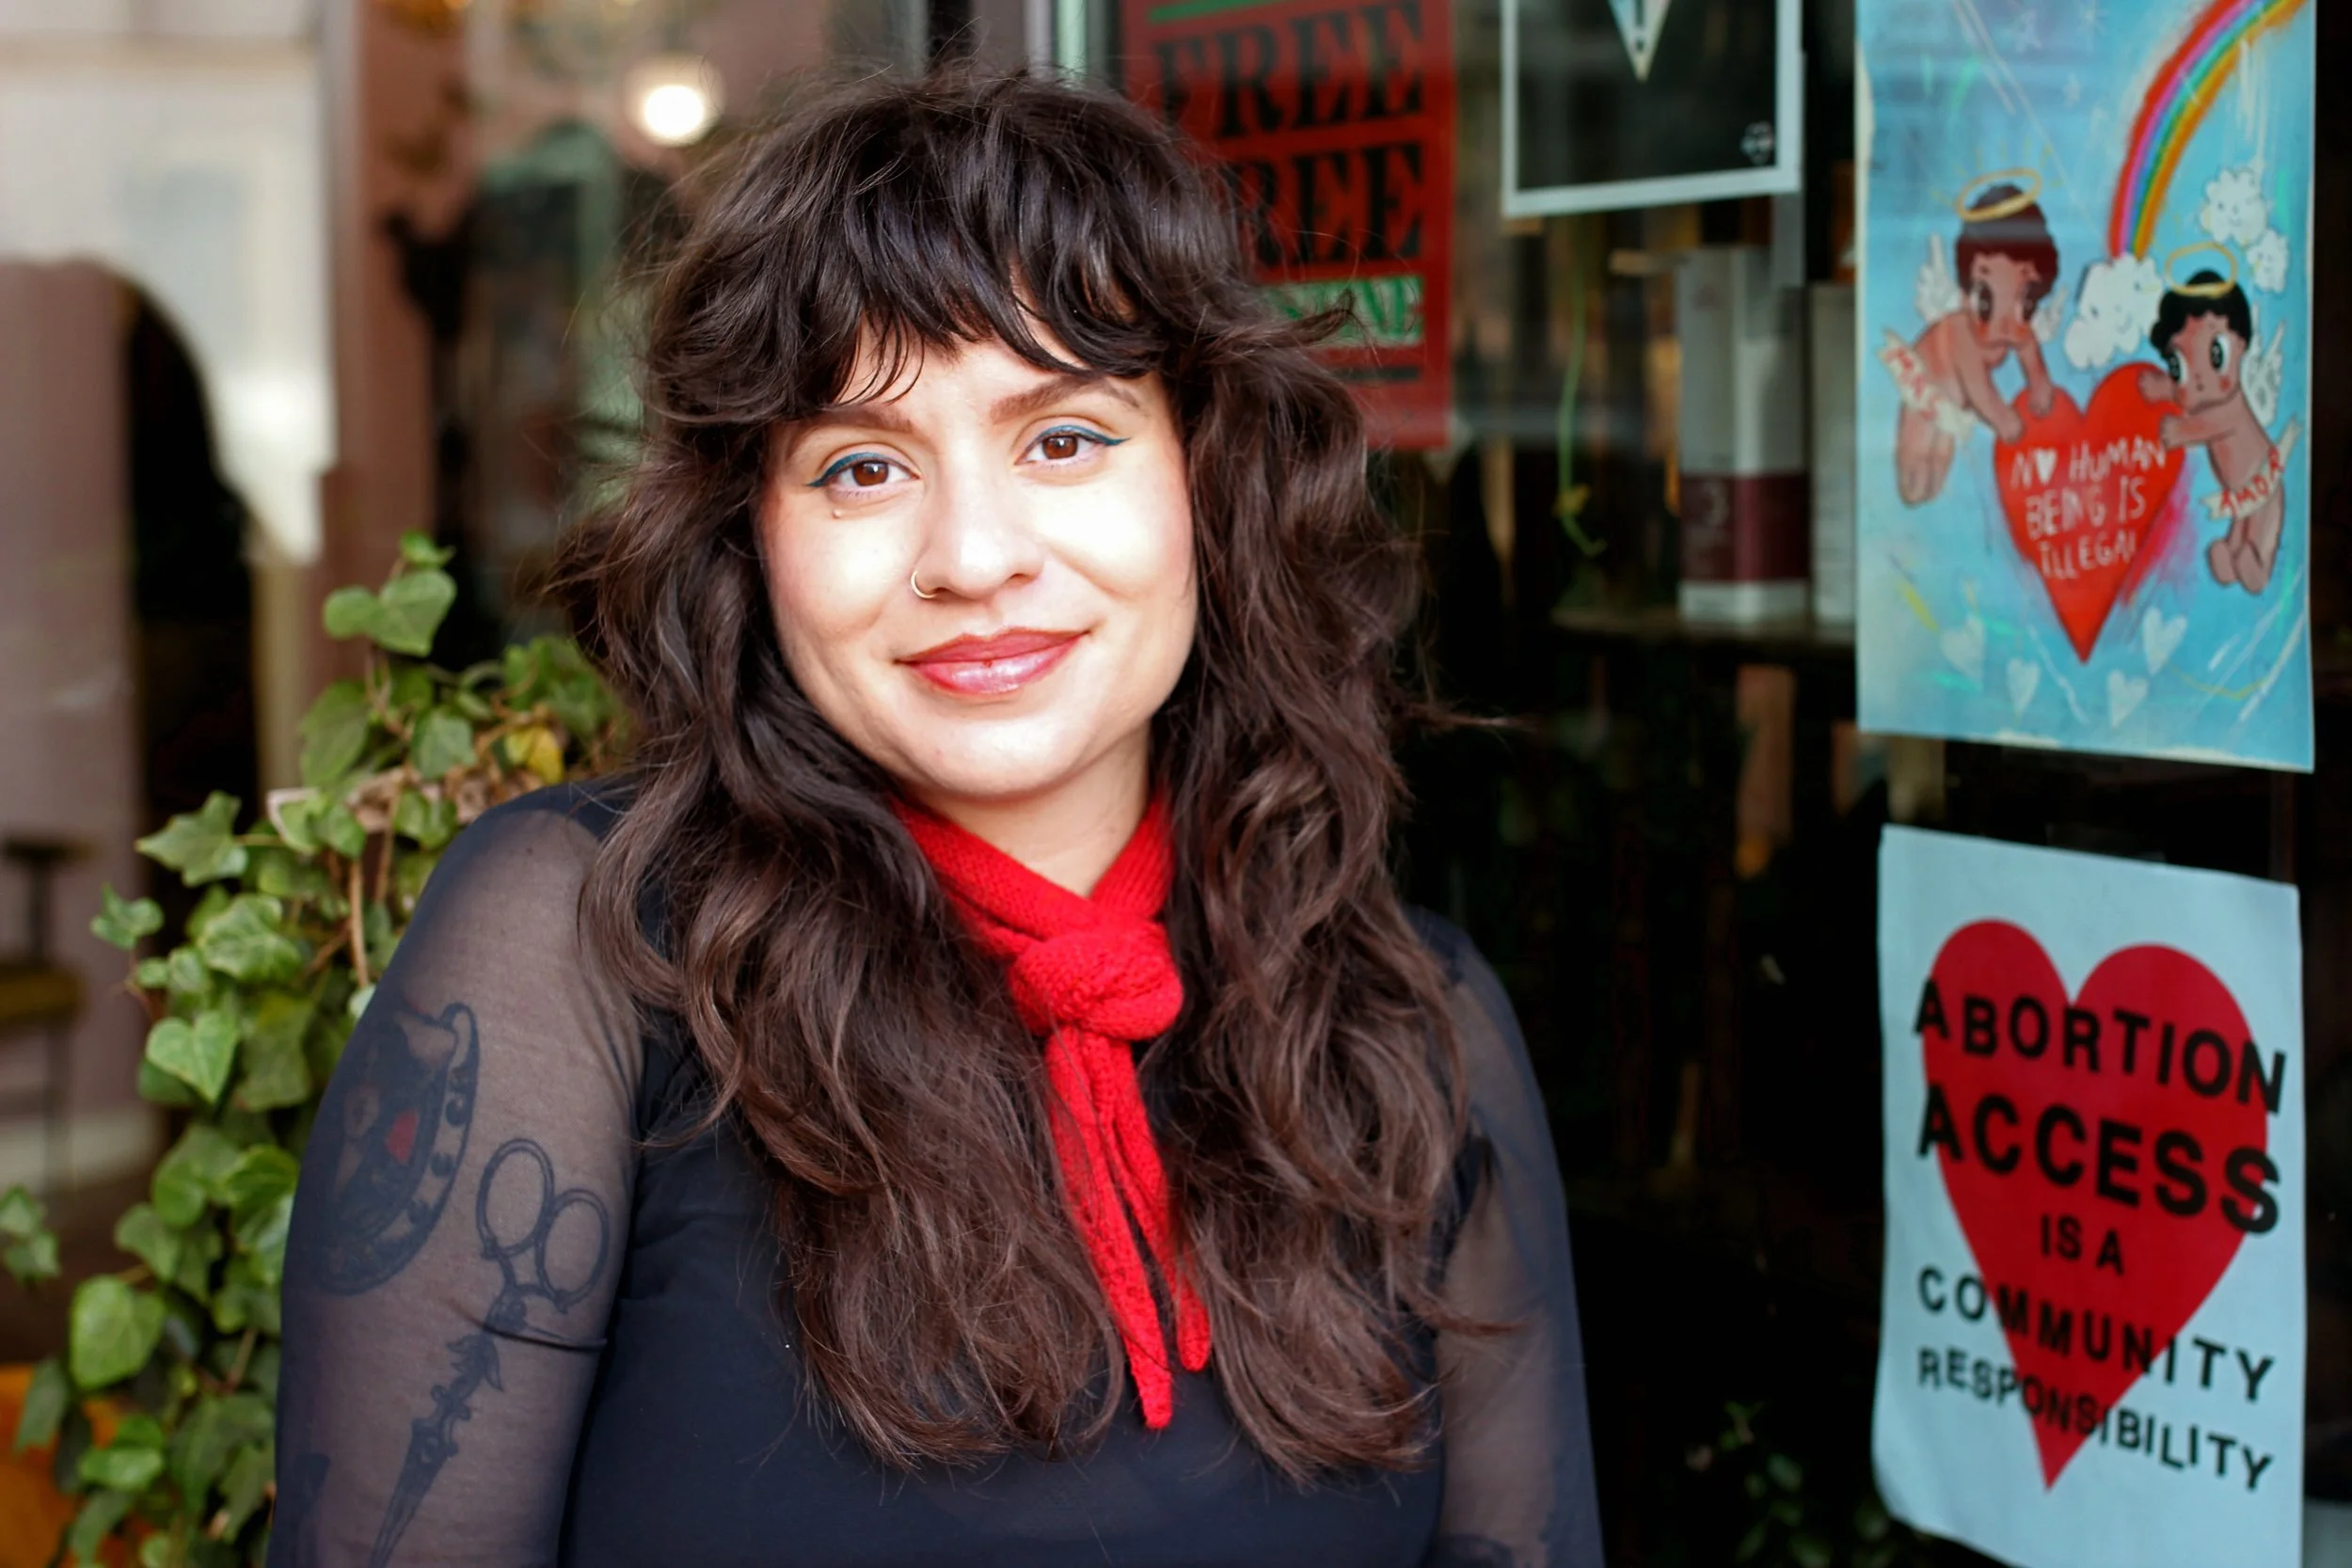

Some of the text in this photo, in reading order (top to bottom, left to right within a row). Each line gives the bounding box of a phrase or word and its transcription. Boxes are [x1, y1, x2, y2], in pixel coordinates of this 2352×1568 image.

[1152, 4, 1422, 137] FREE
[1223, 144, 1422, 267] REE
[2070, 436, 2167, 483] HUMAN
[2120, 475, 2146, 523] IS
[1915, 977, 2286, 1115] ABORTION
[1916, 1083, 2280, 1235] ACCESS
[2041, 1212, 2124, 1276] IS A
[1917, 1265, 2275, 1403] COMMUNITY
[1916, 1346, 2274, 1492] RESPONSIBILITY
